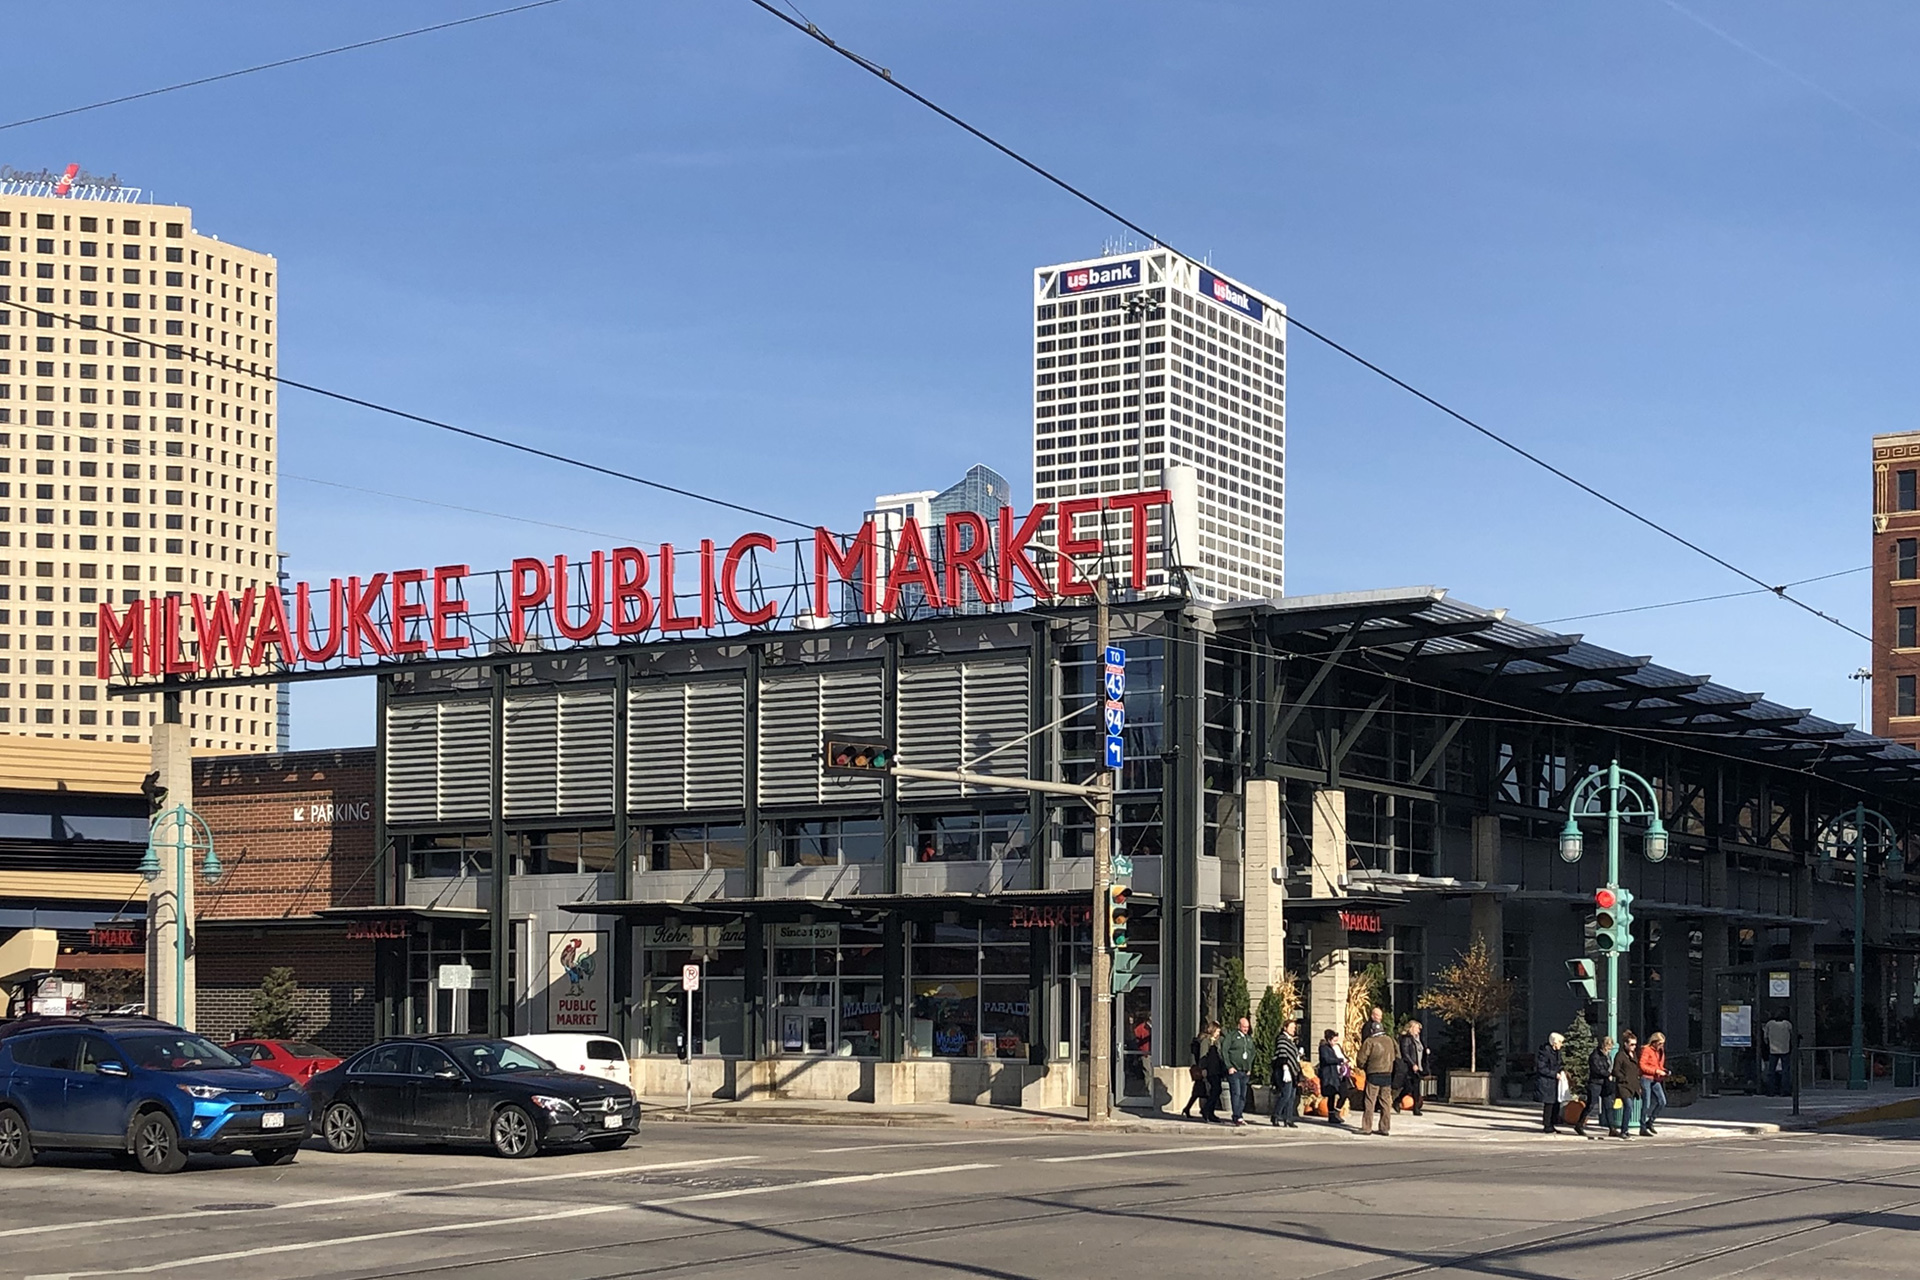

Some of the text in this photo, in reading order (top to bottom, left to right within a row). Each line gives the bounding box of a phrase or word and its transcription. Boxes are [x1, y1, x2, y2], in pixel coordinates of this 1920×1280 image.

[1067, 263, 1133, 289] usbank
[1213, 280, 1250, 310] usbank
[98, 490, 1172, 680] MILWAUKEE PUBLIC MARKET
[1110, 651, 1121, 663] TO
[1107, 674, 1123, 695] 43
[1106, 709, 1122, 730] 94
[311, 802, 370, 823] PARKING
[1011, 905, 1093, 928] MARKET
[780, 926, 833, 939] Since 1930
[559, 999, 596, 1012] PUBLIC
[556, 1014, 598, 1026] MARKET
